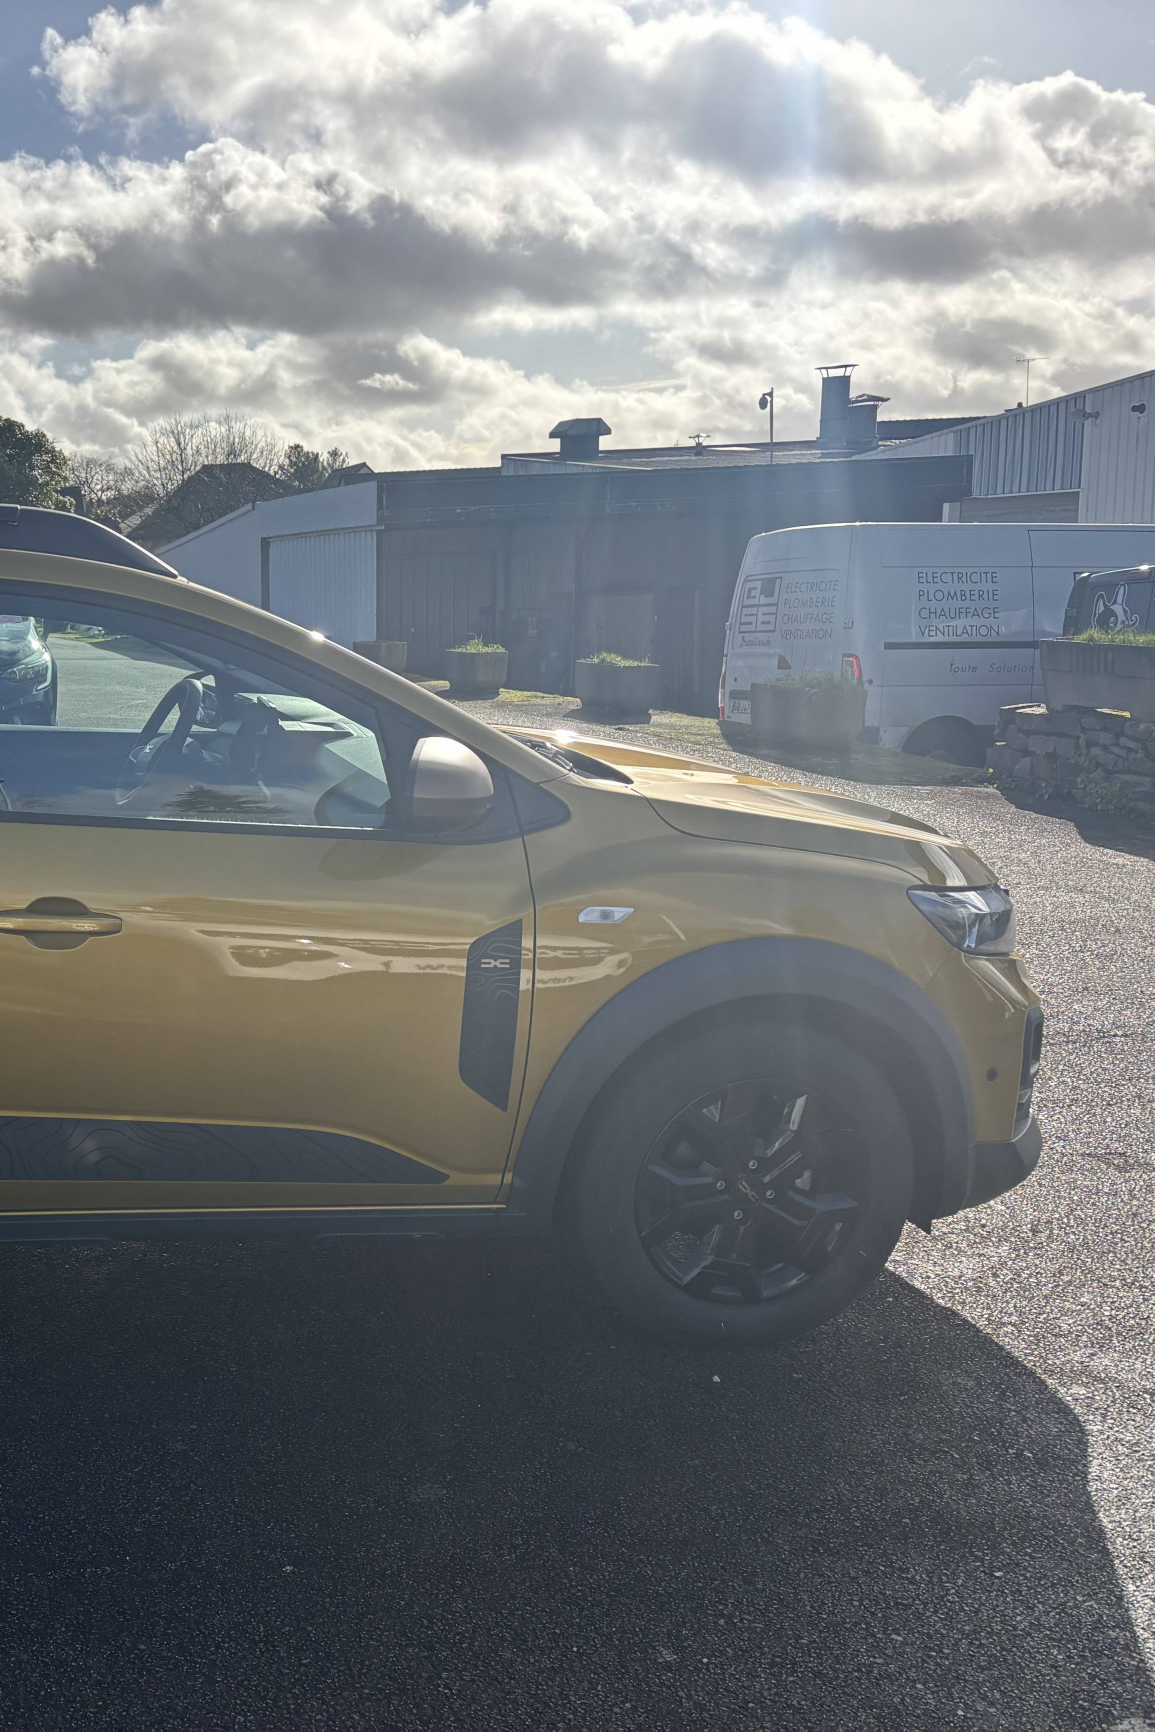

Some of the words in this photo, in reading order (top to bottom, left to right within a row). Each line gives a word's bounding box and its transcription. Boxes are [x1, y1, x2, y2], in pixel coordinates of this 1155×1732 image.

[917, 571, 998, 584] ELECTRICITE
[785, 580, 839, 594] ELECTRICITE
[918, 589, 999, 602] PLOMBERIE
[783, 596, 837, 609] PLOMBERIE
[781, 612, 834, 625] CHAUFFAGE
[918, 606, 1000, 620] CHAUFFAGE
[780, 628, 833, 640] VENTILATION
[918, 624, 1000, 637] VENTILATION
[949, 663, 978, 673] Toute
